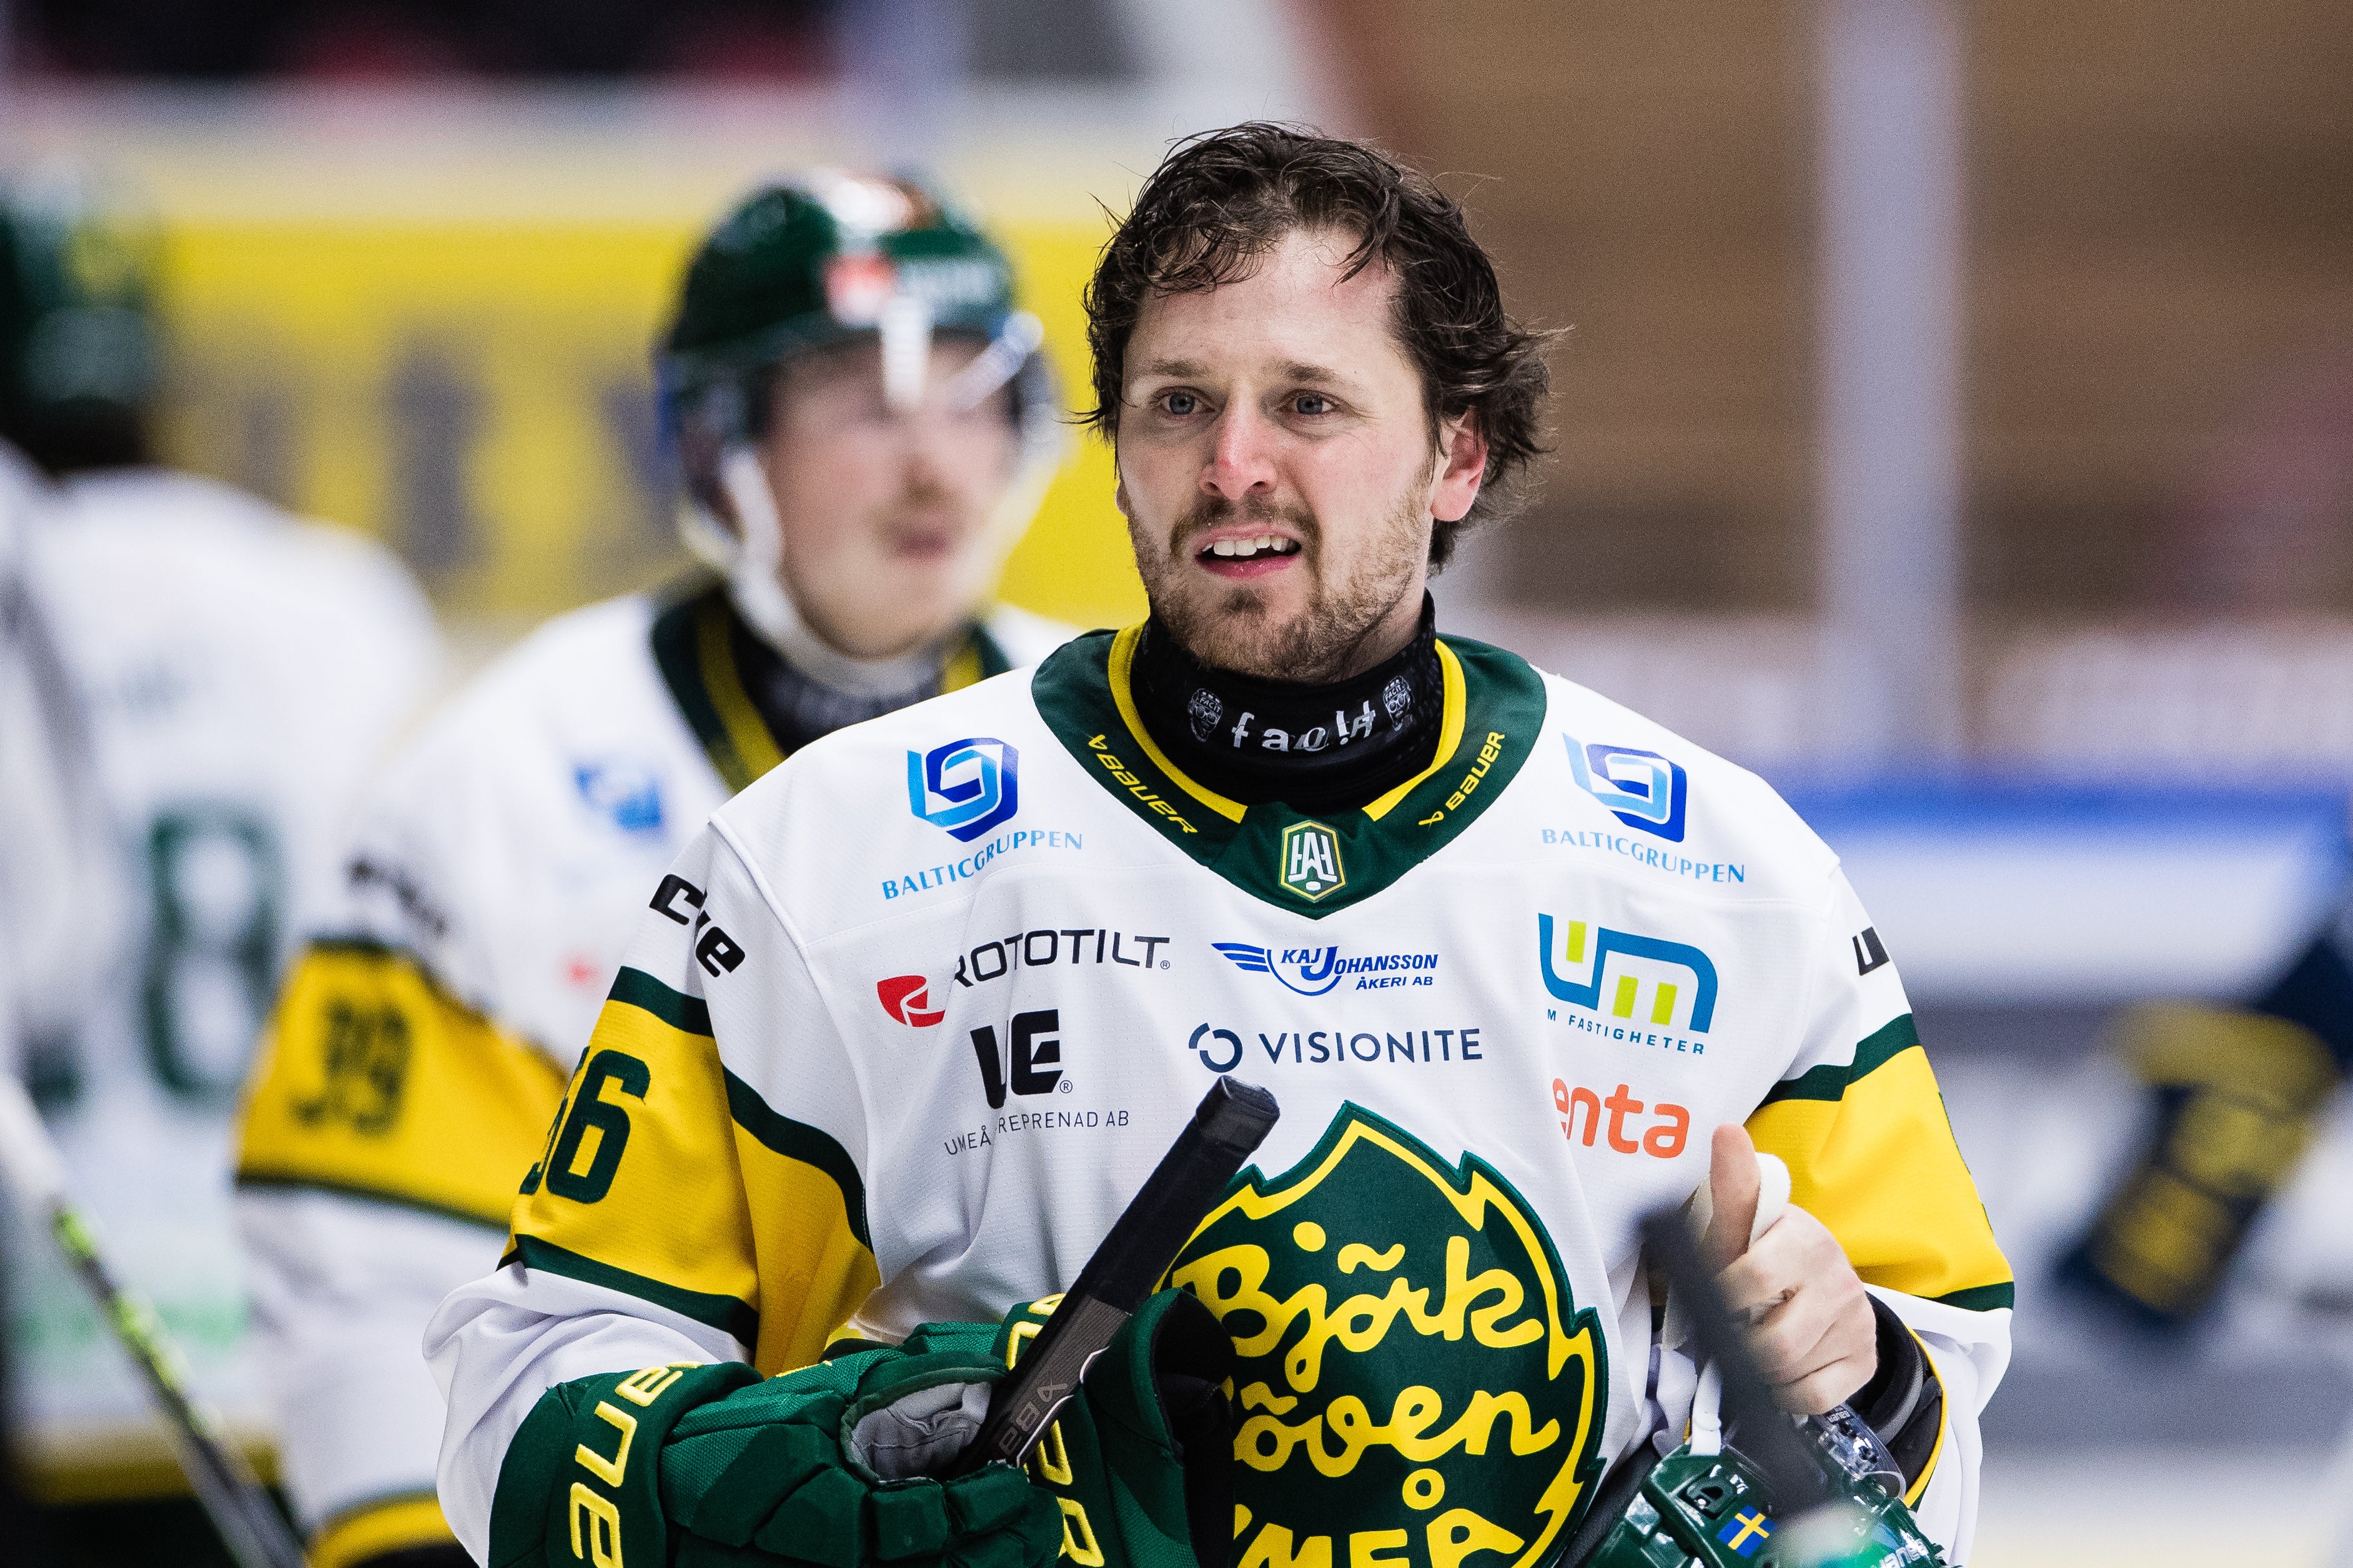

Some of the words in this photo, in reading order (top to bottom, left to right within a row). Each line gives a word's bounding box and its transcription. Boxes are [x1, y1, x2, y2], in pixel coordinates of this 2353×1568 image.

[1199, 697, 1221, 713] FACIT
[1385, 684, 1402, 702] FACIT
[1096, 753, 1197, 834] BAUER
[1445, 731, 1505, 811] BAUER
[881, 830, 1082, 900] BALTICGRUPPEN
[1541, 829, 1745, 883] BALTICGRUPPEN
[1300, 945, 1439, 980] JOHANSSON
[1355, 976, 1407, 990] ÅKERI
[1412, 976, 1434, 986] AB
[1258, 1028, 1483, 1064] VISIONITE
[1568, 1015, 1705, 1055] FASTIGHETER
[518, 1045, 651, 1205] 6
[944, 1125, 992, 1155] UMEÅ
[998, 1111, 1098, 1133] REPRENAD
[1106, 1110, 1129, 1127] AB
[1222, 1374, 1561, 1477] öven
[1234, 1467, 1525, 1568] MEÅ
